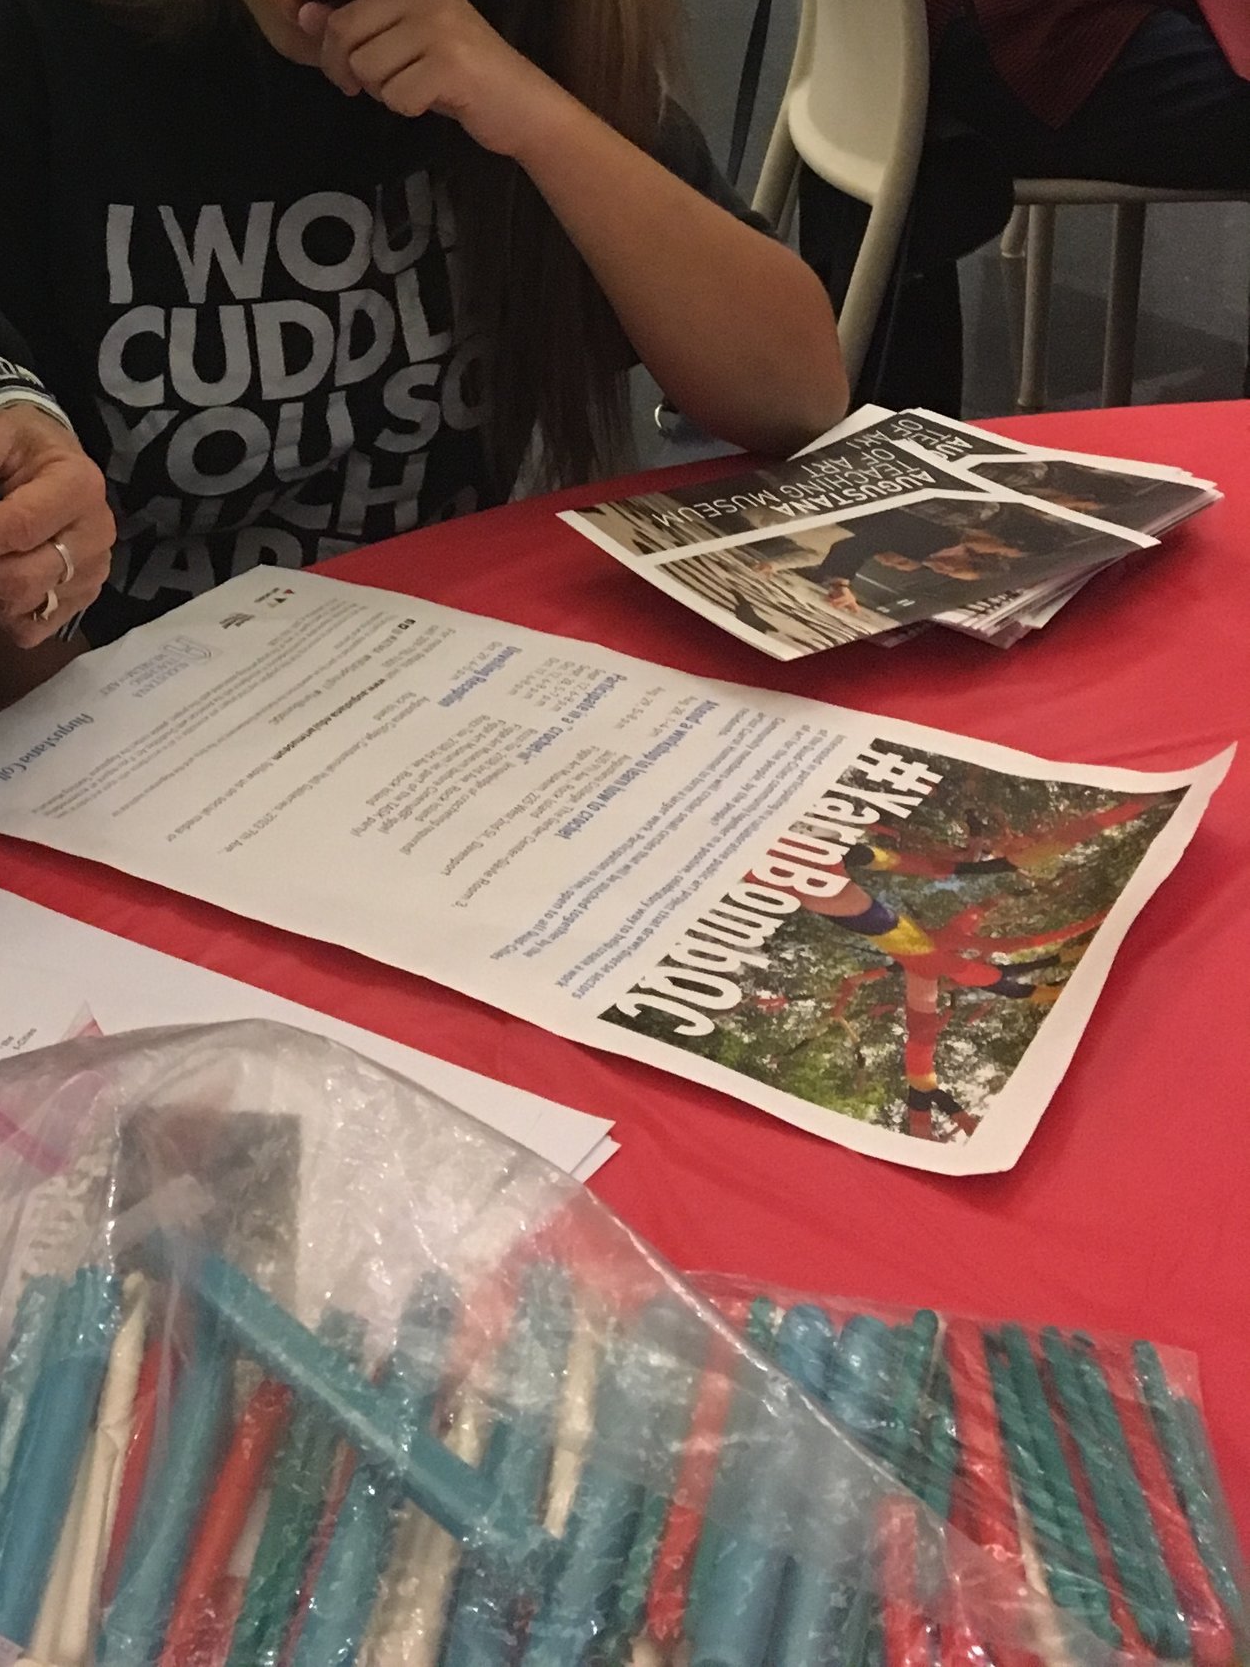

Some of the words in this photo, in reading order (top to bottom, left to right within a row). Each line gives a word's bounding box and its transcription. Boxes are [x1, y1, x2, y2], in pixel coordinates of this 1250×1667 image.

[106, 203, 136, 304] I
[158, 170, 455, 304] WOU
[97, 267, 454, 407] CUDDL
[95, 391, 356, 497] YOU
[859, 447, 896, 470] OF
[778, 459, 913, 500] TEACHING
[801, 454, 858, 479] ART
[652, 490, 780, 528] MUSEUM
[769, 471, 937, 518] AUGUSTANA
[438, 676, 486, 706] Reception
[576, 673, 626, 710] Participate
[567, 710, 582, 718] in
[24, 712, 94, 763] Augustana
[643, 729, 686, 760] workshop
[613, 767, 645, 786] learn
[634, 759, 653, 768] to
[586, 801, 606, 811] to
[596, 785, 624, 801] how
[555, 810, 593, 839] crochet
[614, 746, 945, 1037] #YarnBombQC
